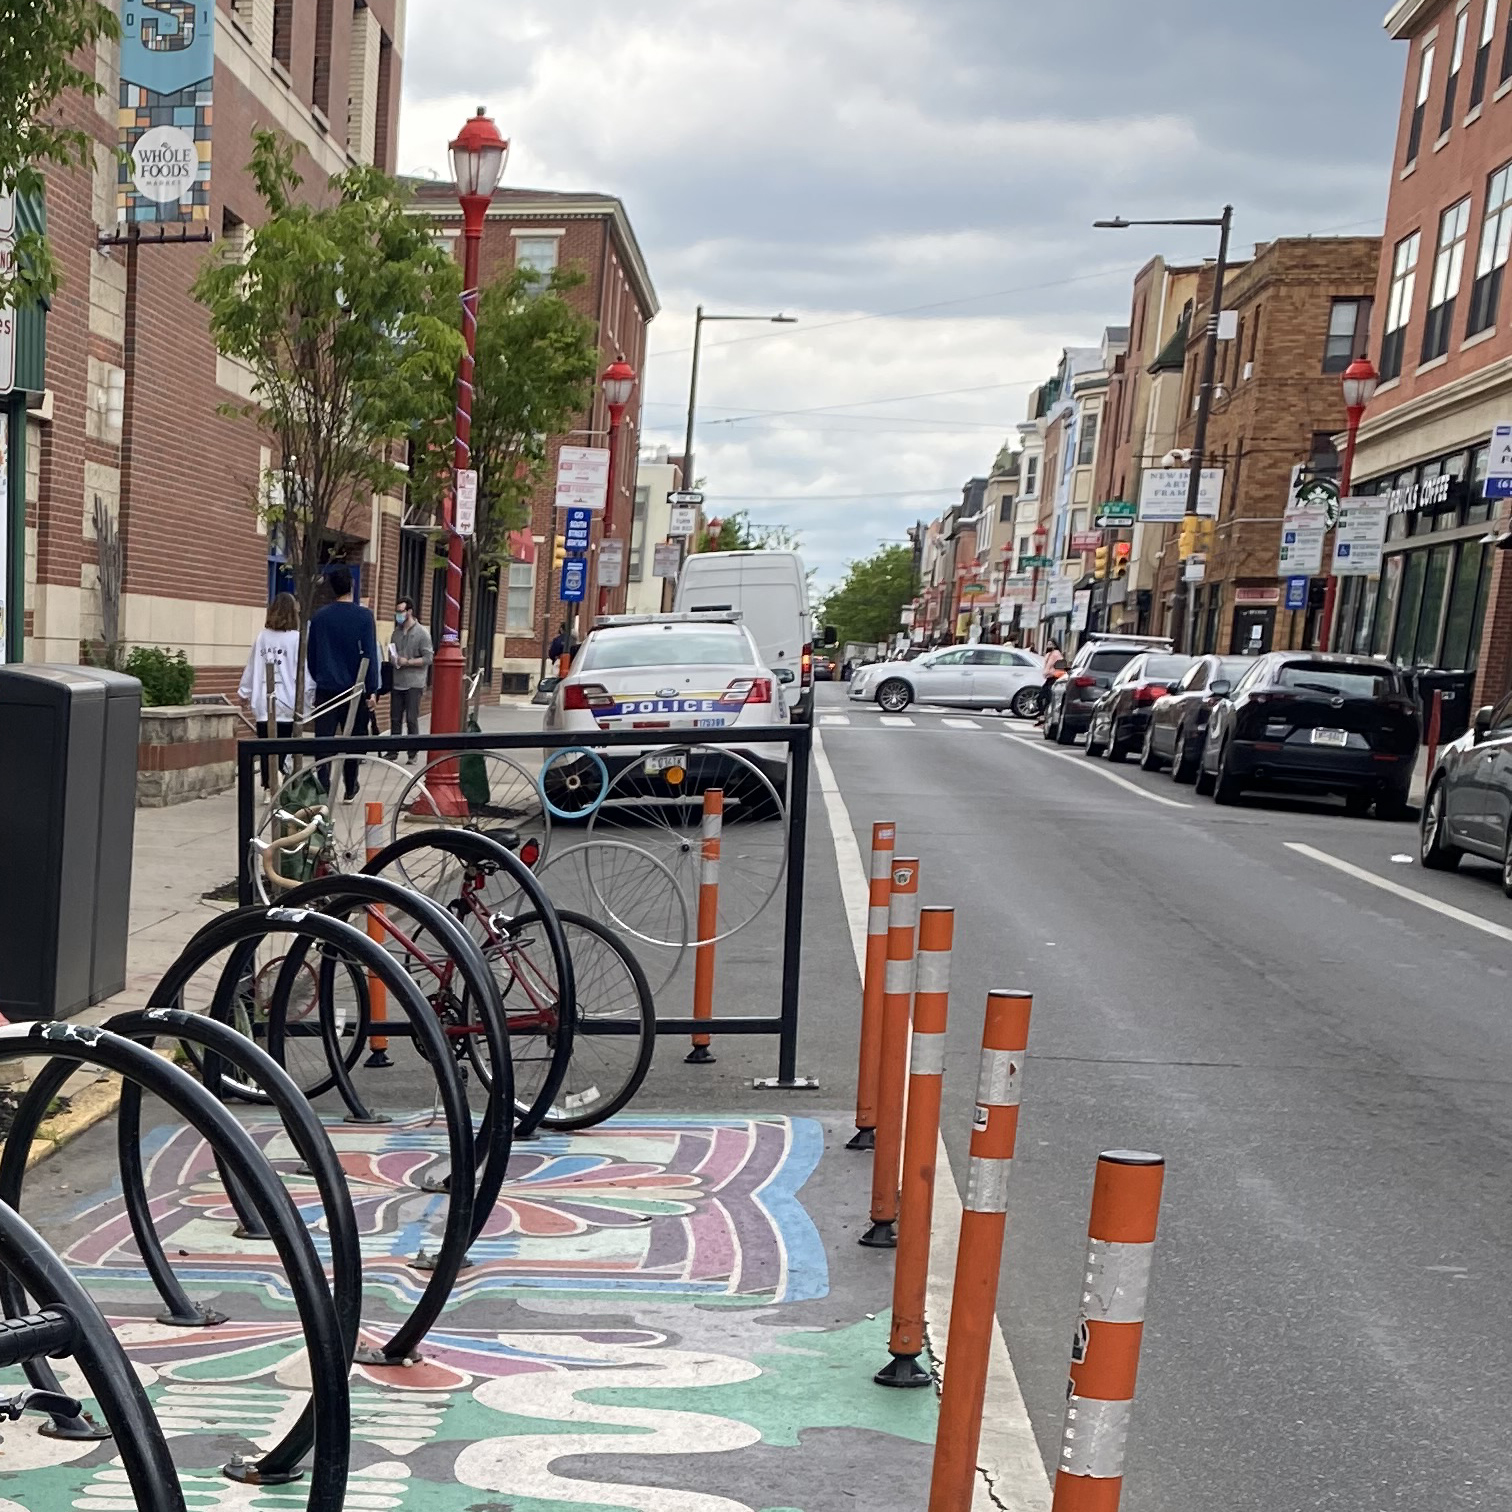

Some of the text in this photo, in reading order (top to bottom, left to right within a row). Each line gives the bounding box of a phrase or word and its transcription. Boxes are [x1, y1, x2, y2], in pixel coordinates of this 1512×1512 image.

[138, 147, 192, 163] WHOLE
[140, 164, 190, 178] FOODS
[1154, 489, 1207, 497] FRAMG
[621, 700, 714, 714] POLICE
